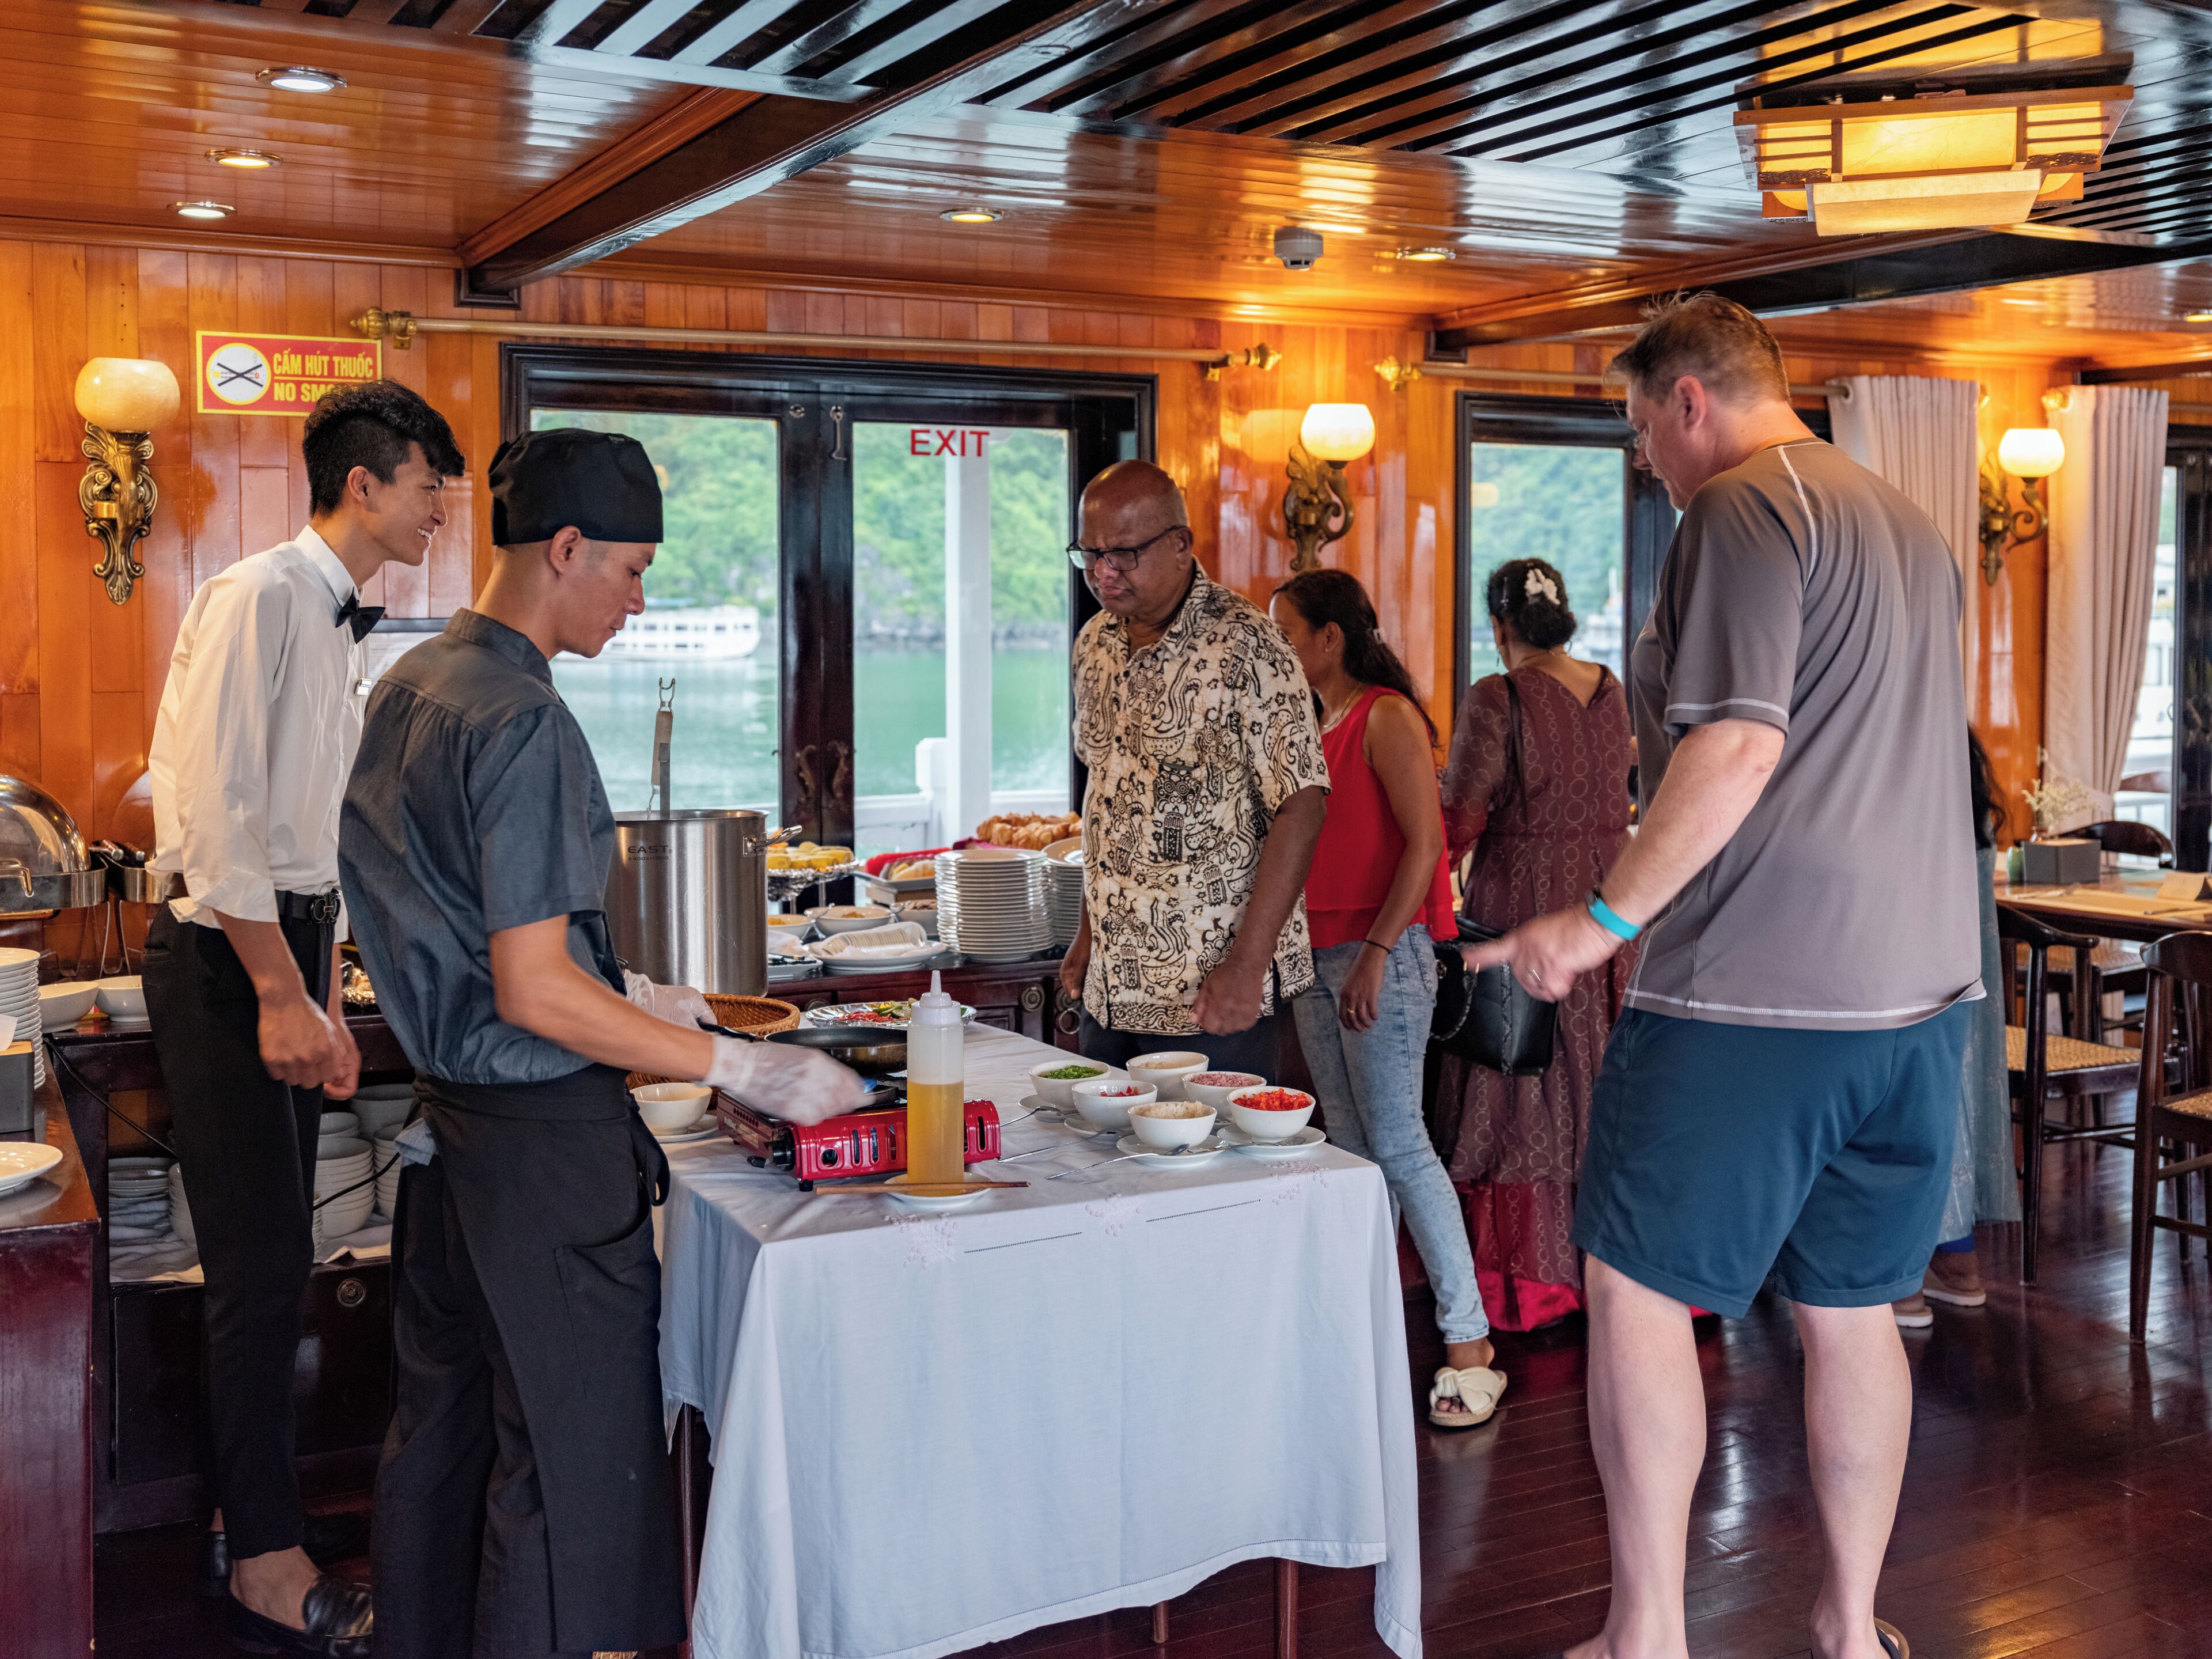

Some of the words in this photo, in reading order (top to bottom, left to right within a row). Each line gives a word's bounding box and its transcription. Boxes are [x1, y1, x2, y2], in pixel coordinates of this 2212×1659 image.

[273, 348, 302, 374] CẤM
[305, 350, 330, 376] HÚT
[332, 351, 374, 378] THUỐC
[274, 382, 296, 402] NO
[910, 429, 990, 457] EXIT
